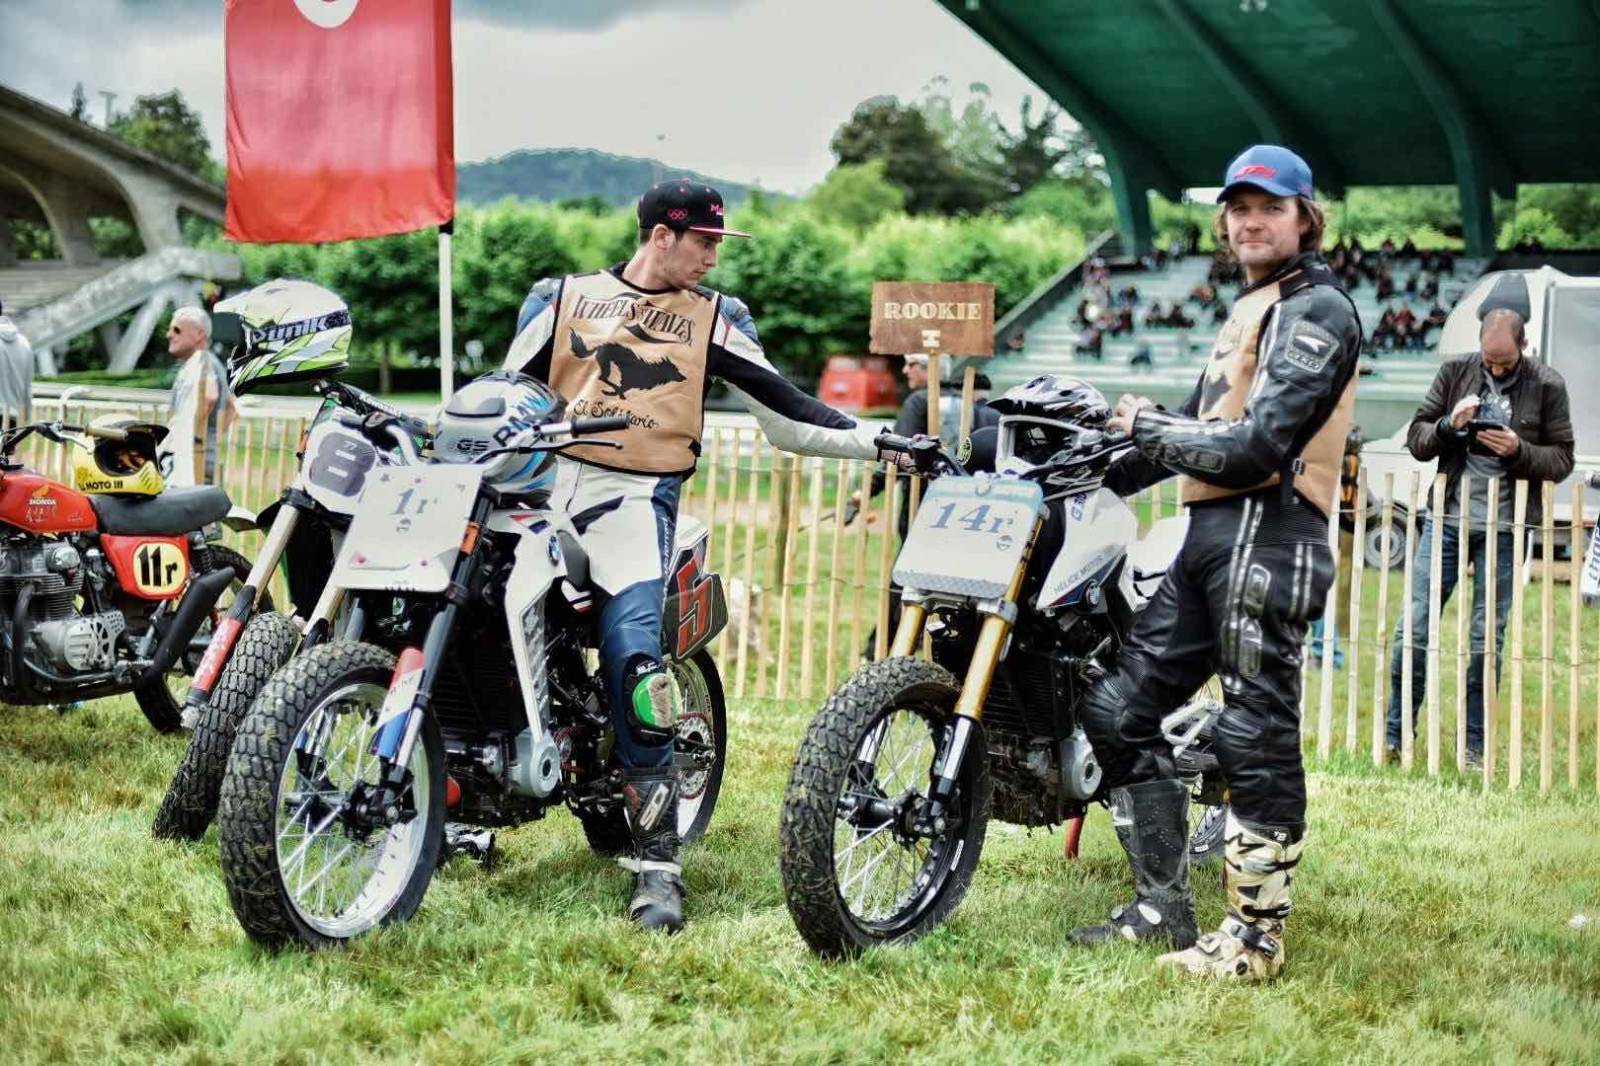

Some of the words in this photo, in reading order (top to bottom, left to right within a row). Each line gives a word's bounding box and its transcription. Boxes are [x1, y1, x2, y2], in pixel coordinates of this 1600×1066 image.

[884, 302, 982, 320] ROOKIE
[457, 439, 490, 452] GS
[137, 544, 178, 587] 11r
